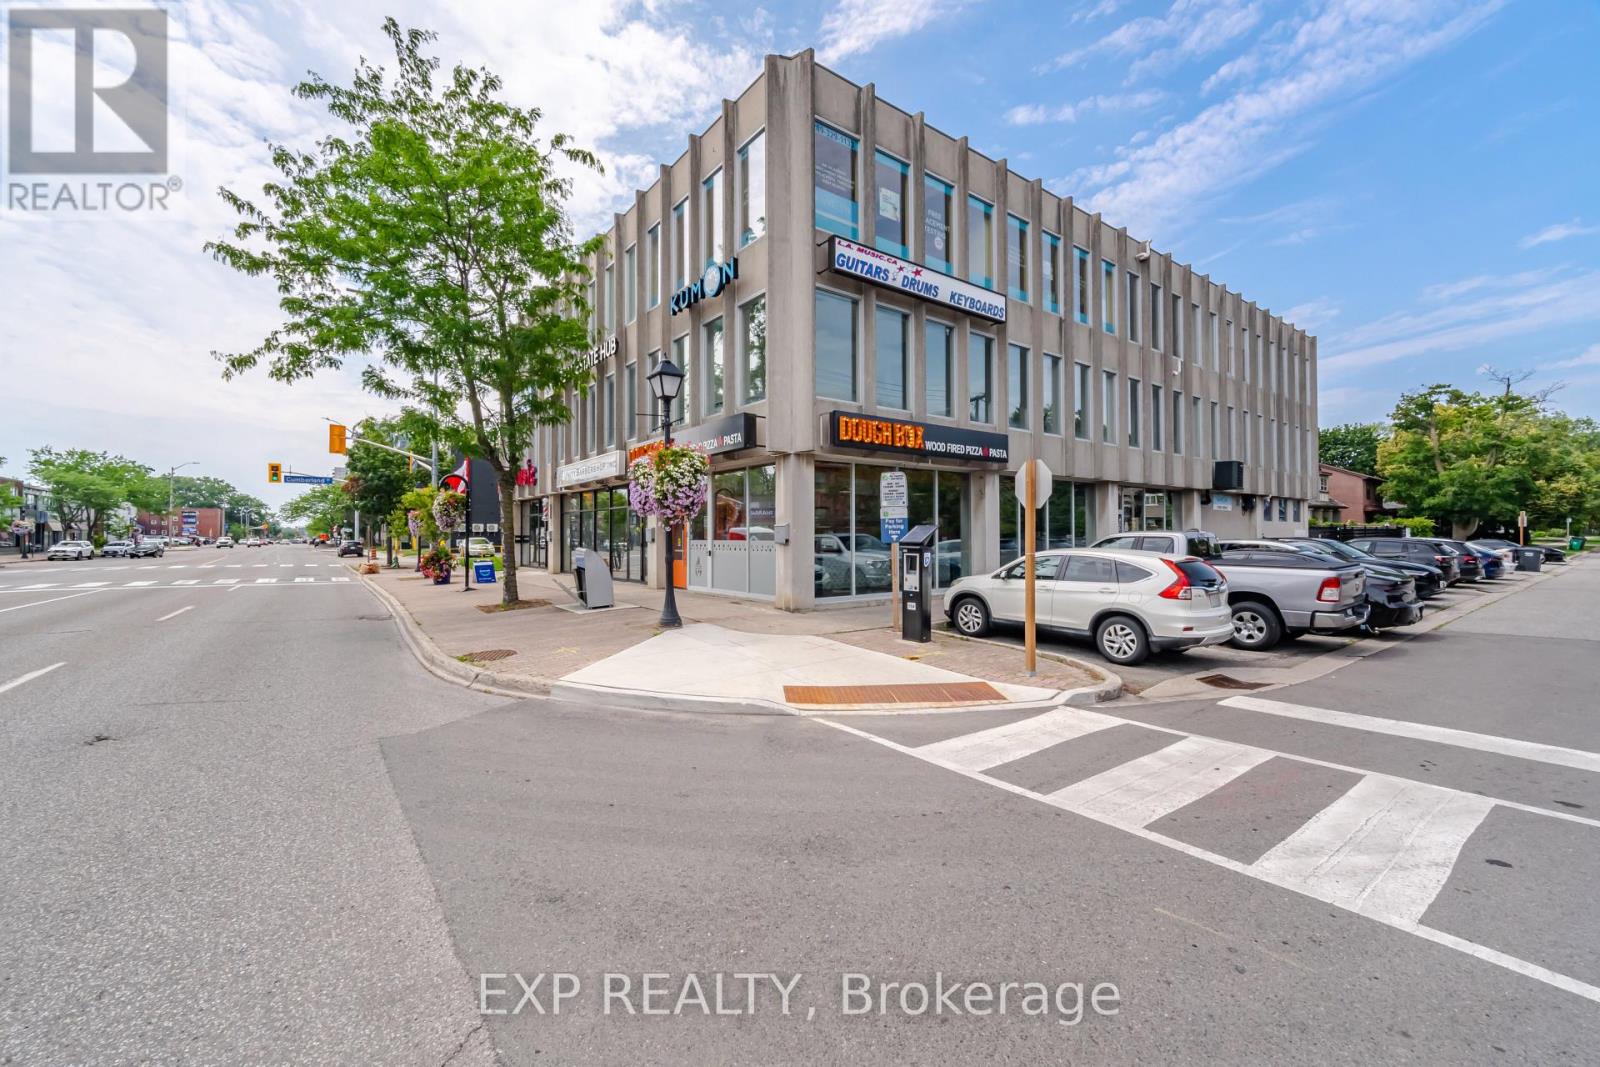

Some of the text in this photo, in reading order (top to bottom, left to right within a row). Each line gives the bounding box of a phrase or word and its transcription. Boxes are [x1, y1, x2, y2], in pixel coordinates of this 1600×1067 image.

[671, 256, 738, 316] KUMON
[836, 253, 1005, 318] GUITARS DRUMS KEYBOARDS
[600, 337, 617, 360] HUB
[723, 433, 742, 446] PASTA
[840, 415, 925, 449] DOUGH BOX
[925, 441, 1008, 458] WOOD FIRED PIZZA PASTA
